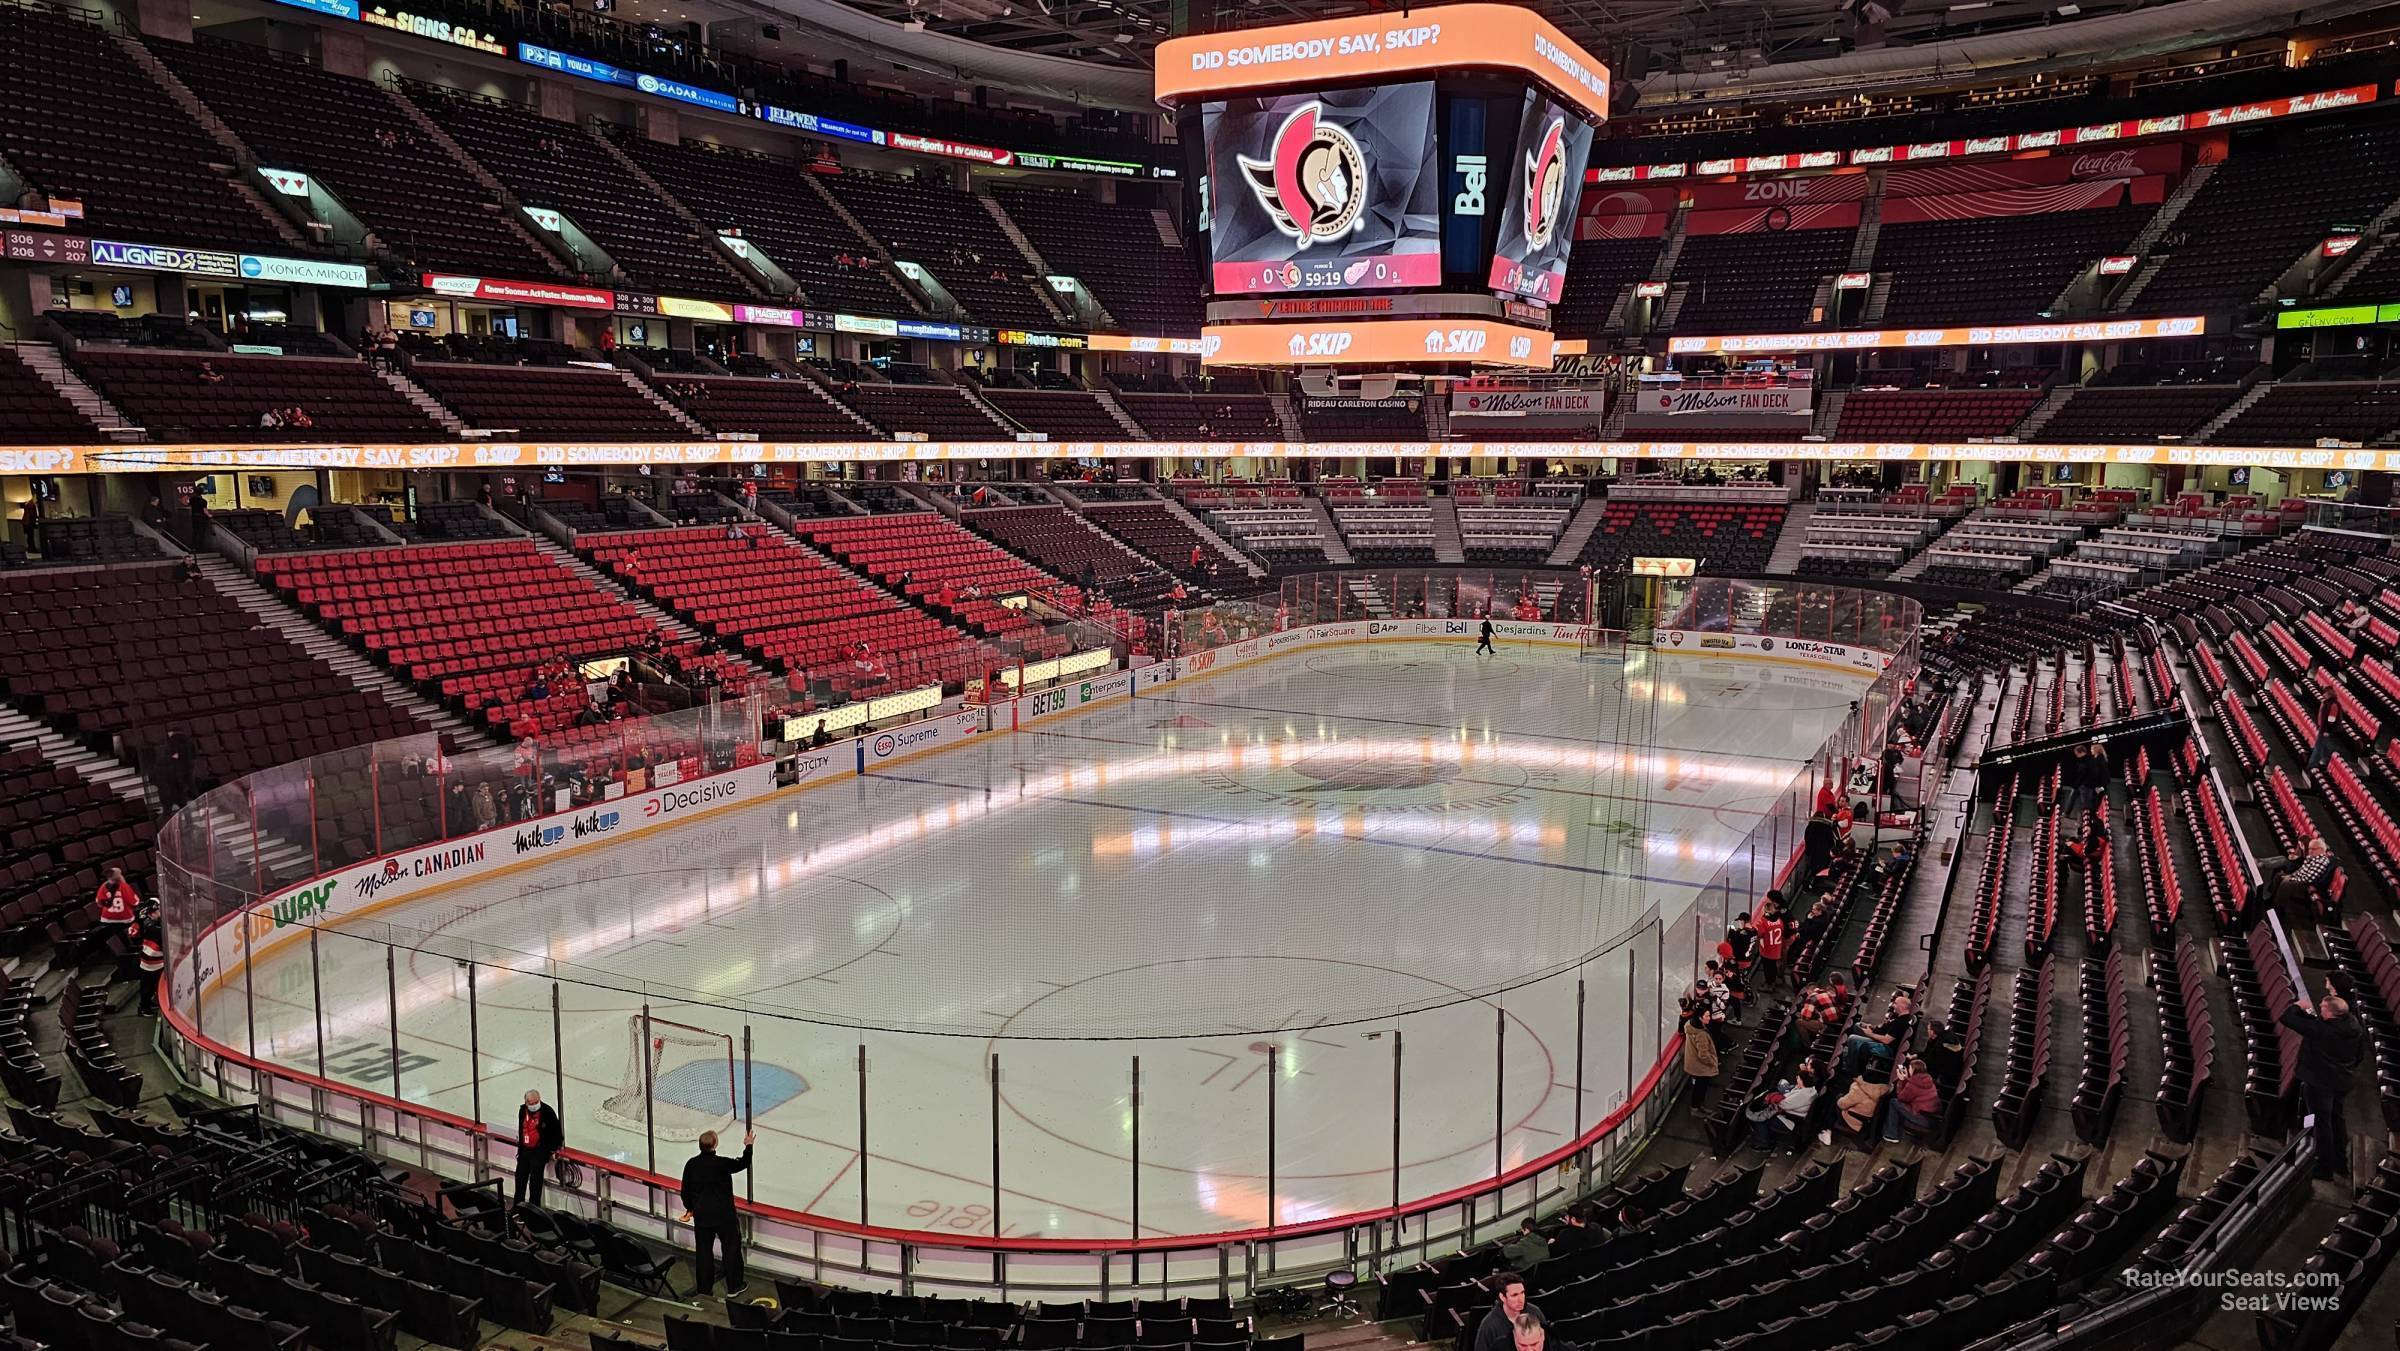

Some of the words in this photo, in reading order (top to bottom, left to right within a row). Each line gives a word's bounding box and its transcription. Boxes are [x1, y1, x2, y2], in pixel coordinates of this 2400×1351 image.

[396, 12, 476, 48] SIGNS.CA
[1192, 52, 1224, 71] DID
[1226, 38, 1336, 66] SOMEBODY
[1338, 32, 1382, 55] SAY,
[1385, 24, 1441, 49] SKIP?
[566, 58, 592, 74] YOW.CA
[1534, 32, 1547, 56] DID
[1546, 42, 1582, 80] SOMEBODY
[1590, 74, 1606, 98] SKIP?
[659, 84, 698, 101] GADAR
[2288, 96, 2311, 114] Tim
[2311, 92, 2358, 110] Hortons
[2208, 108, 2229, 126] Tim
[2230, 106, 2272, 124] Hortons
[894, 133, 944, 152] PowerSports
[946, 144, 952, 153] &
[954, 145, 964, 155] RV
[964, 147, 993, 160] CANADA
[2072, 151, 2138, 176] Coca-Cola
[1455, 155, 1488, 216] Bell
[1745, 180, 1810, 200] ZONE
[1199, 175, 1209, 232] Bell
[11, 235, 34, 244] 306
[64, 240, 86, 250] 307
[12, 247, 34, 258] 206
[66, 252, 86, 262] 207
[95, 246, 180, 268] ALIGNED
[266, 263, 314, 278] KONICA
[316, 267, 366, 281] MINOLTA
[1263, 268, 1274, 284] 0
[1306, 272, 1341, 287] 59:19
[1376, 264, 1386, 280] 0
[1508, 268, 1514, 284] 0
[485, 285, 504, 294] Know
[530, 288, 541, 298] Act
[562, 292, 586, 302] Remove
[616, 294, 629, 302] 308
[755, 308, 792, 321] MAGENTA
[1968, 329, 1992, 342] DID
[1994, 326, 2071, 341] SOMEBODY
[2104, 323, 2142, 336] SKIP?
[2168, 320, 2197, 333] SKIP
[1170, 340, 1186, 350] DID
[1306, 332, 1351, 356] SKIP
[1445, 330, 1487, 353] SKIP
[1516, 335, 1532, 358] SKIP
[1721, 338, 1743, 349] DID
[1744, 336, 1815, 348] SOMEBODY
[1846, 333, 1880, 346] SKIP?
[1915, 332, 1944, 344] SKIP
[1308, 400, 1336, 408] RIDEAU
[1338, 400, 1377, 408] CARLETON
[1378, 400, 1406, 408] CASINO
[1482, 393, 1542, 412] Molson
[1544, 396, 1562, 409] FAN
[1564, 396, 1590, 410] DECK
[1674, 392, 1738, 411] Molson
[1740, 394, 1760, 408] FAN
[1762, 393, 1788, 408] DECK
[0, 449, 74, 470] SKIP?
[364, 448, 407, 466] SAY,
[409, 447, 460, 464] SKIP?
[490, 446, 522, 464] SKIP
[536, 447, 564, 463] DID
[567, 447, 652, 462] SOMEBODY
[654, 447, 684, 462] SAY,
[685, 446, 720, 460] SKIP?
[1485, 446, 1505, 456] DID
[1506, 445, 1576, 457] SOMEBODY
[1606, 446, 1640, 456] SKIP?
[1928, 447, 1952, 460] DID
[1954, 447, 2035, 460] SOMEBODY
[2068, 448, 2106, 460] SKIP?
[2168, 450, 2192, 462] DID
[2194, 450, 2271, 466] SOMEBODY
[2300, 452, 2335, 466] SKIP?
[177, 486, 194, 494] 105
[1316, 627, 1356, 639] FairSquare
[1416, 623, 1437, 634] Fibe
[1446, 622, 1468, 634] Bell
[1496, 624, 1546, 637] Desjardins
[1552, 625, 1573, 640] Tim
[1786, 640, 1811, 651] LONE
[1823, 645, 1846, 656] STAR
[1198, 650, 1216, 671] SKIP
[1817, 654, 1832, 662] GRILL
[1083, 678, 1126, 698] enterprise
[1032, 688, 1066, 716] BET99
[878, 740, 892, 752] Esso
[898, 727, 938, 748] Supreme
[663, 780, 736, 813] Decisive
[354, 865, 409, 898] Molson
[415, 842, 485, 878] CANADIAN
[233, 879, 338, 955] SUBWAY
[1768, 928, 1782, 946] 12
